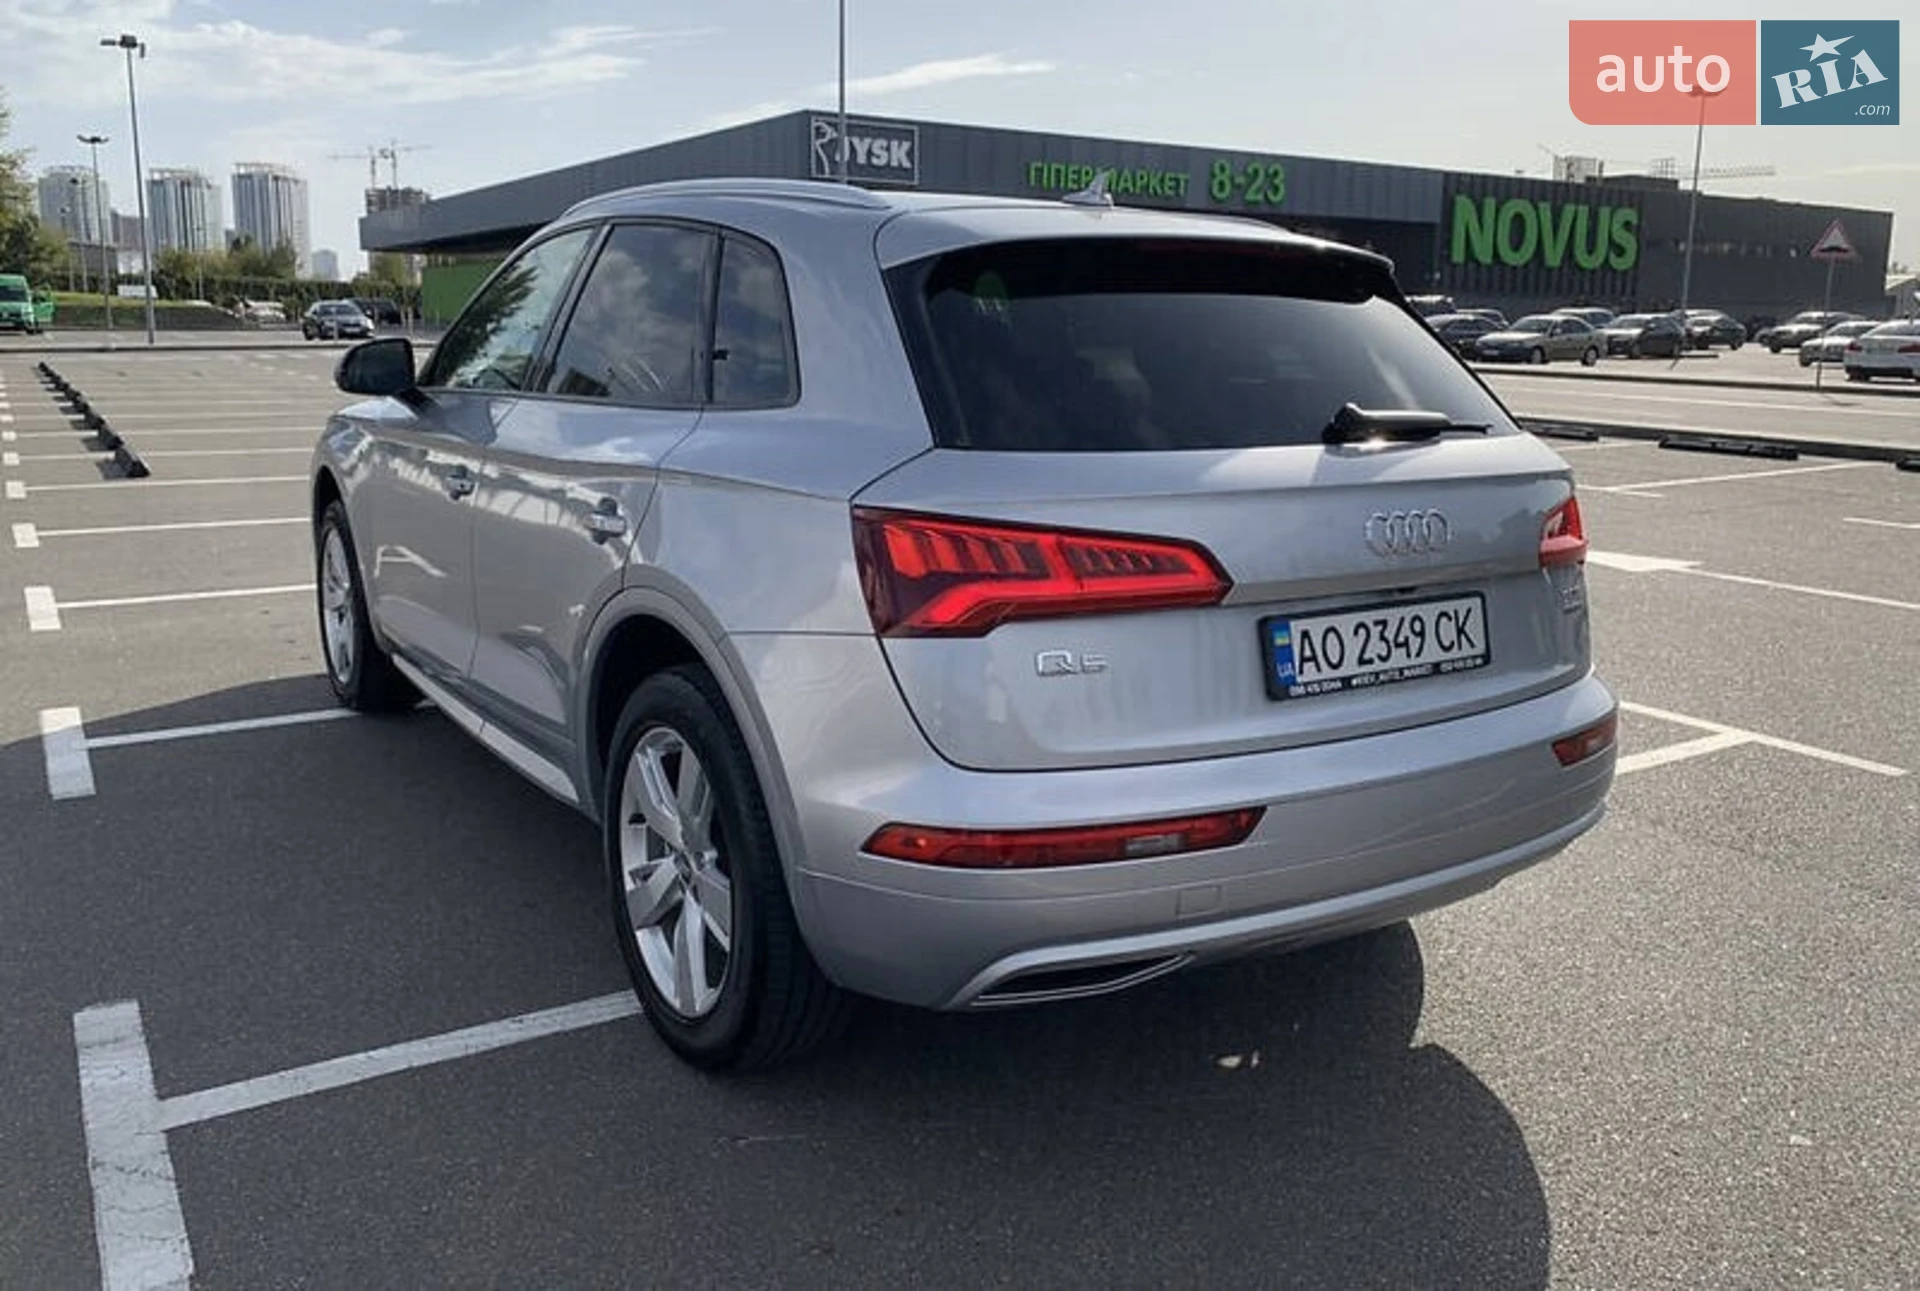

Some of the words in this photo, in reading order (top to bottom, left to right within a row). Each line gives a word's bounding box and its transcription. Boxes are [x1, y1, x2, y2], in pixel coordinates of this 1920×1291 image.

[835, 136, 912, 169] JYSK
[1212, 160, 1285, 202] 8-23
[1451, 195, 1639, 271] NOVUS
[1299, 626, 1345, 674] AO
[1353, 614, 1426, 666] 2349
[1435, 607, 1475, 653] CK
